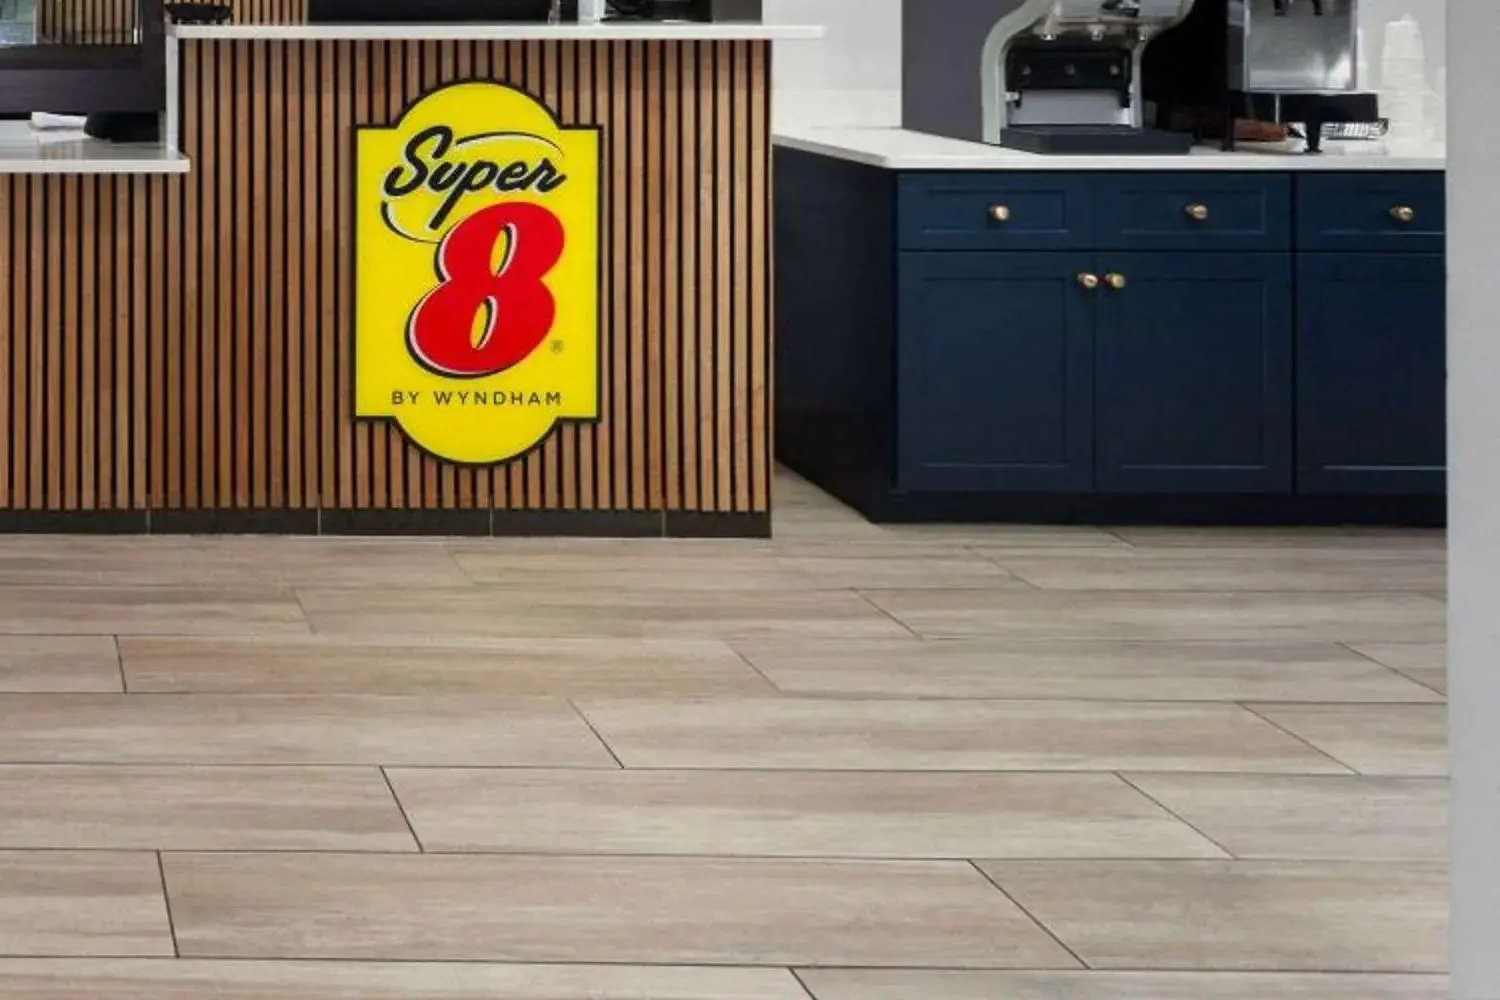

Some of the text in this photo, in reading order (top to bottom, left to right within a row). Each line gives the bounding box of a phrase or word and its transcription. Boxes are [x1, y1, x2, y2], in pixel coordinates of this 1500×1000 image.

[383, 126, 567, 230] Super
[404, 201, 565, 379] 8
[391, 391, 562, 406] BY WYNDHAM
